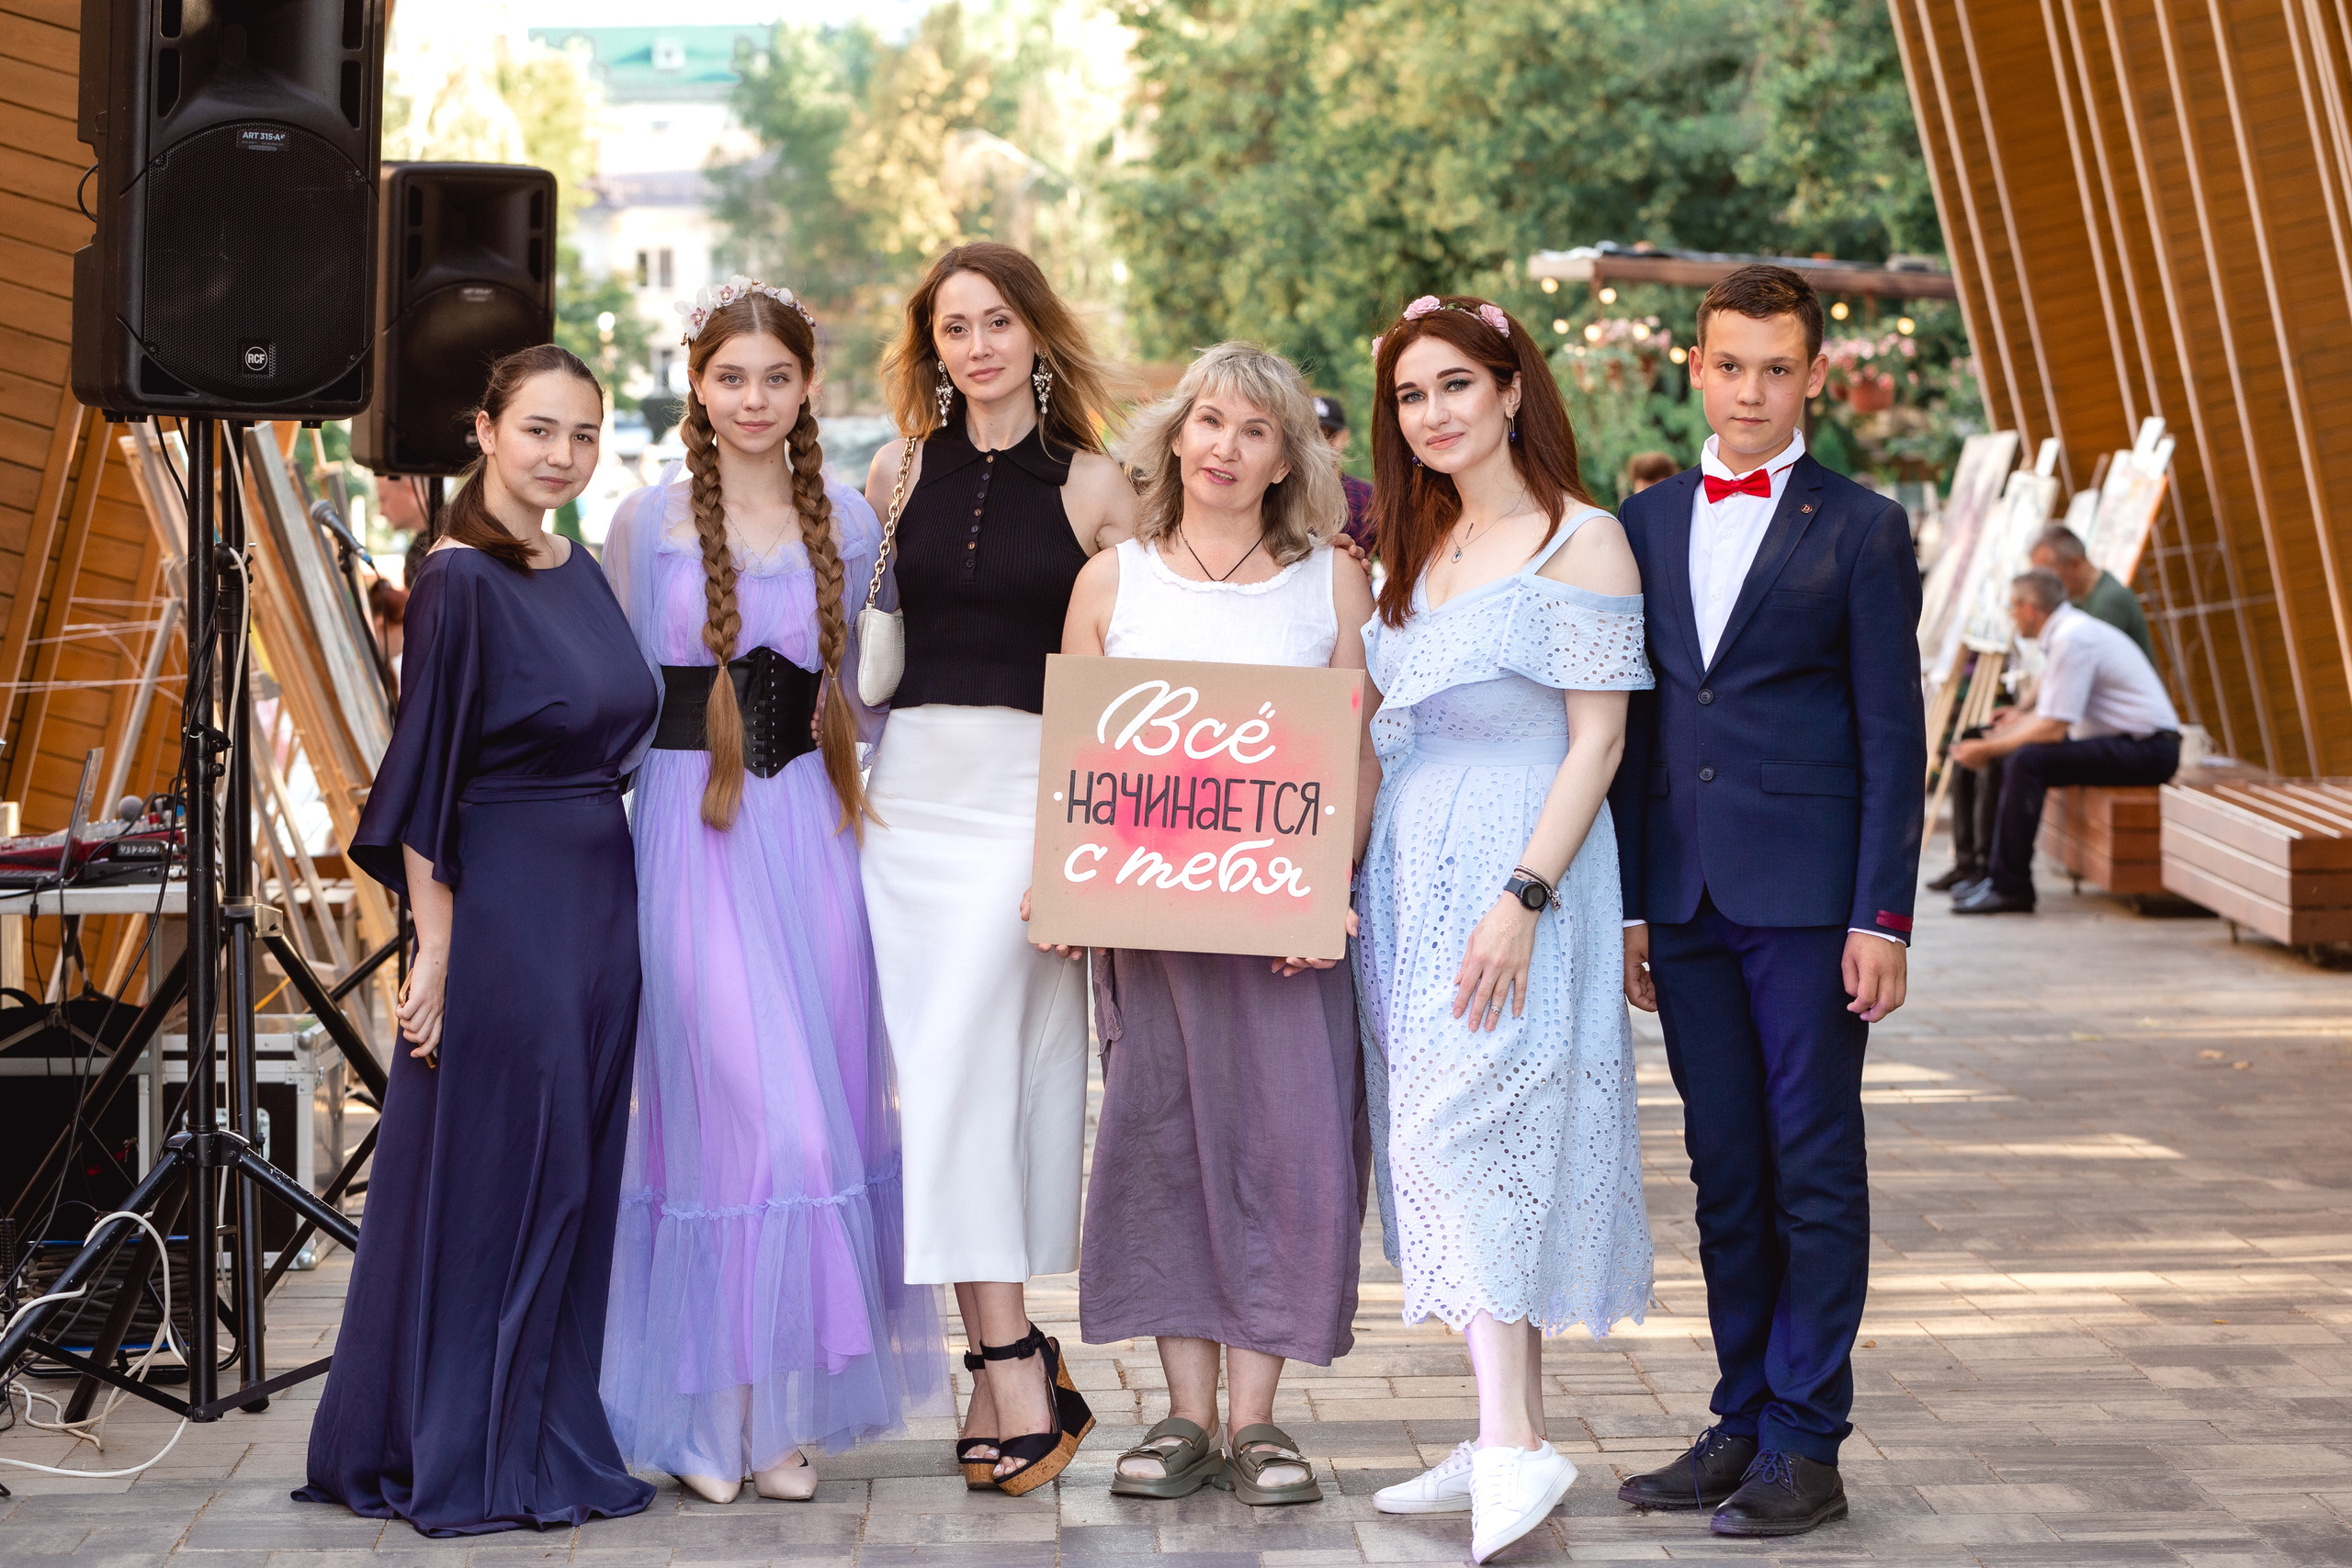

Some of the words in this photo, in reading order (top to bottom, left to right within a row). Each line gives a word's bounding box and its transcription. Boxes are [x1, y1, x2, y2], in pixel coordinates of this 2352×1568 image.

[242, 131, 259, 140] ART
[247, 354, 266, 364] RCF
[1097, 681, 1275, 763] Всё
[1115, 838, 1310, 897] тебя
